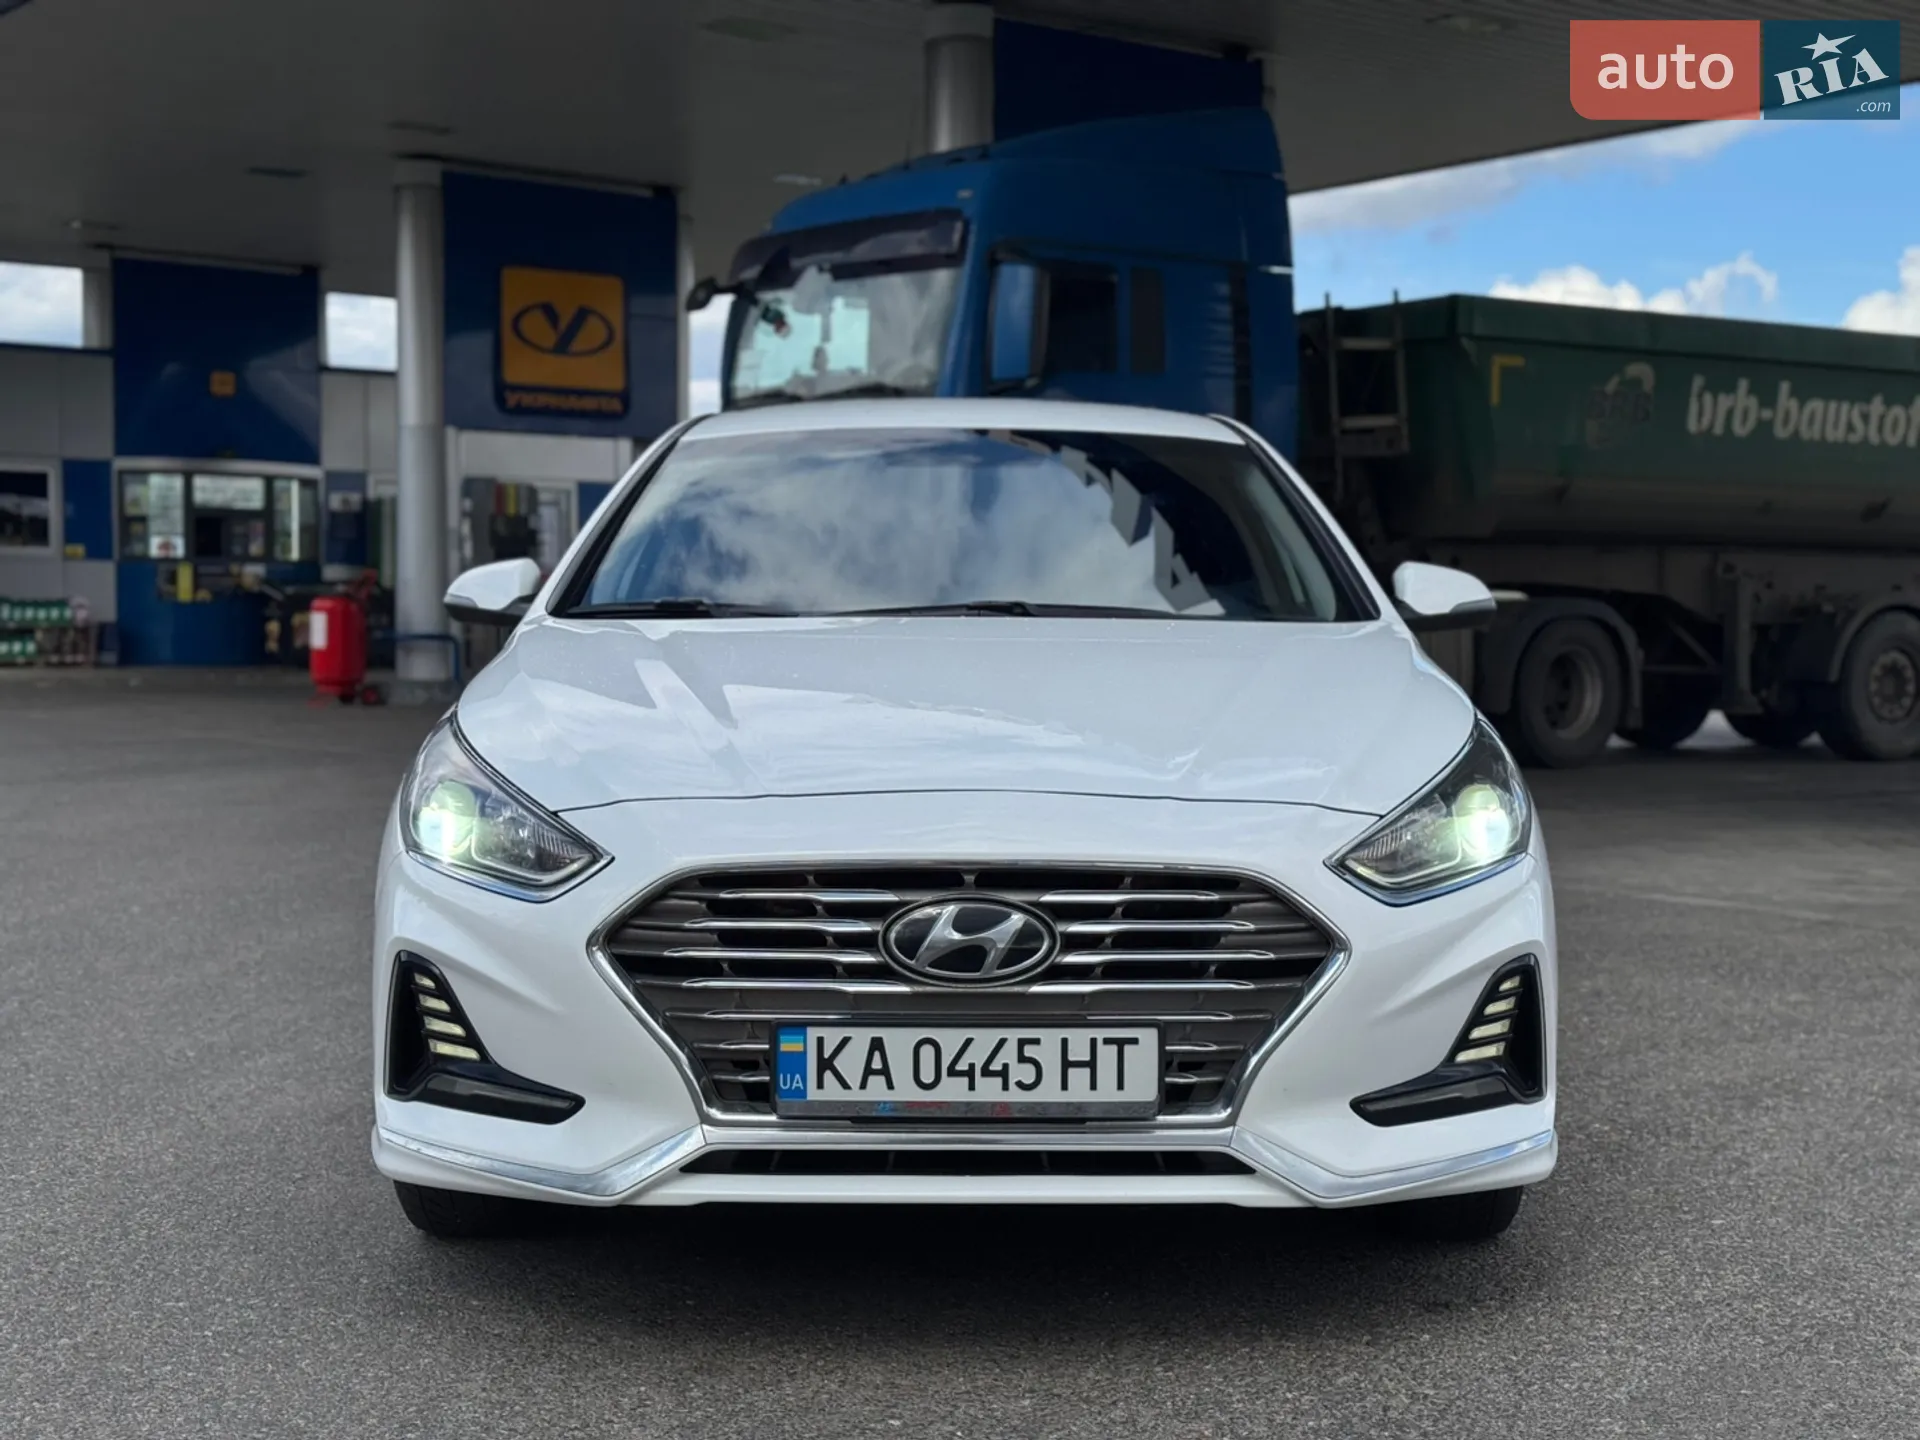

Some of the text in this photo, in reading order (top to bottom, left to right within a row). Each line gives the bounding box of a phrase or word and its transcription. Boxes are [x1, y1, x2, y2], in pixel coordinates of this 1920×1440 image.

[779, 1073, 804, 1091] UA
[816, 1036, 1140, 1092] KA 0445 HT
